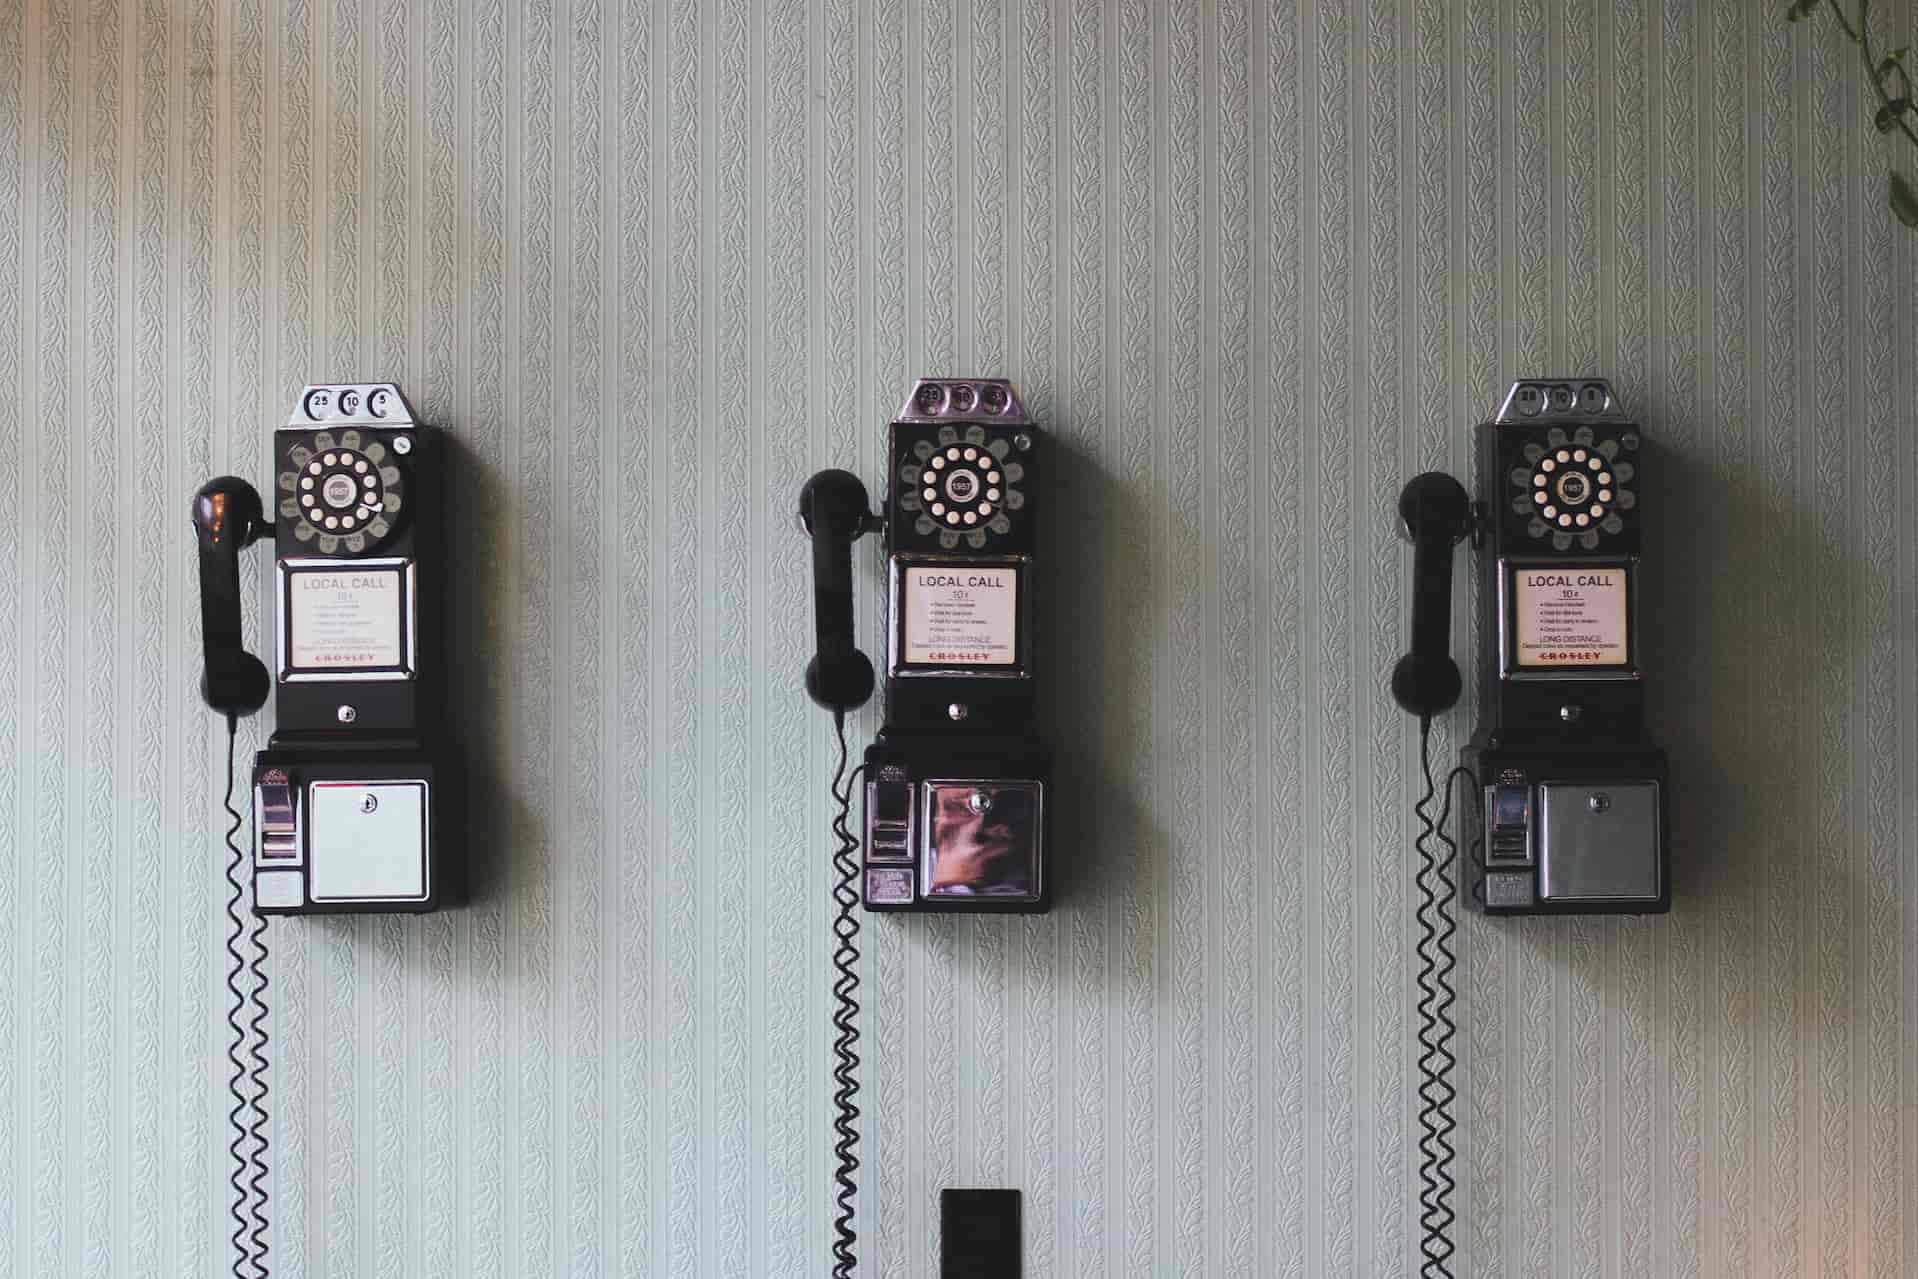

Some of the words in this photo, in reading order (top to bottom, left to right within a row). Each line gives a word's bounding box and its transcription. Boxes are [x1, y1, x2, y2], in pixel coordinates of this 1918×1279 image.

[314, 396, 328, 406] 25
[347, 396, 359, 407] 10
[379, 394, 386, 404] 5
[303, 578, 347, 590] LOCAL
[351, 577, 385, 589] CALL
[919, 575, 965, 587] LOCAL
[968, 576, 1005, 588] CALL
[1527, 575, 1574, 587] LOCAL
[1577, 575, 1614, 586] CALL
[1562, 635, 1602, 643] DISTANCE
[928, 652, 990, 660] CROSLEY
[1539, 652, 1601, 660] CROSLEY
